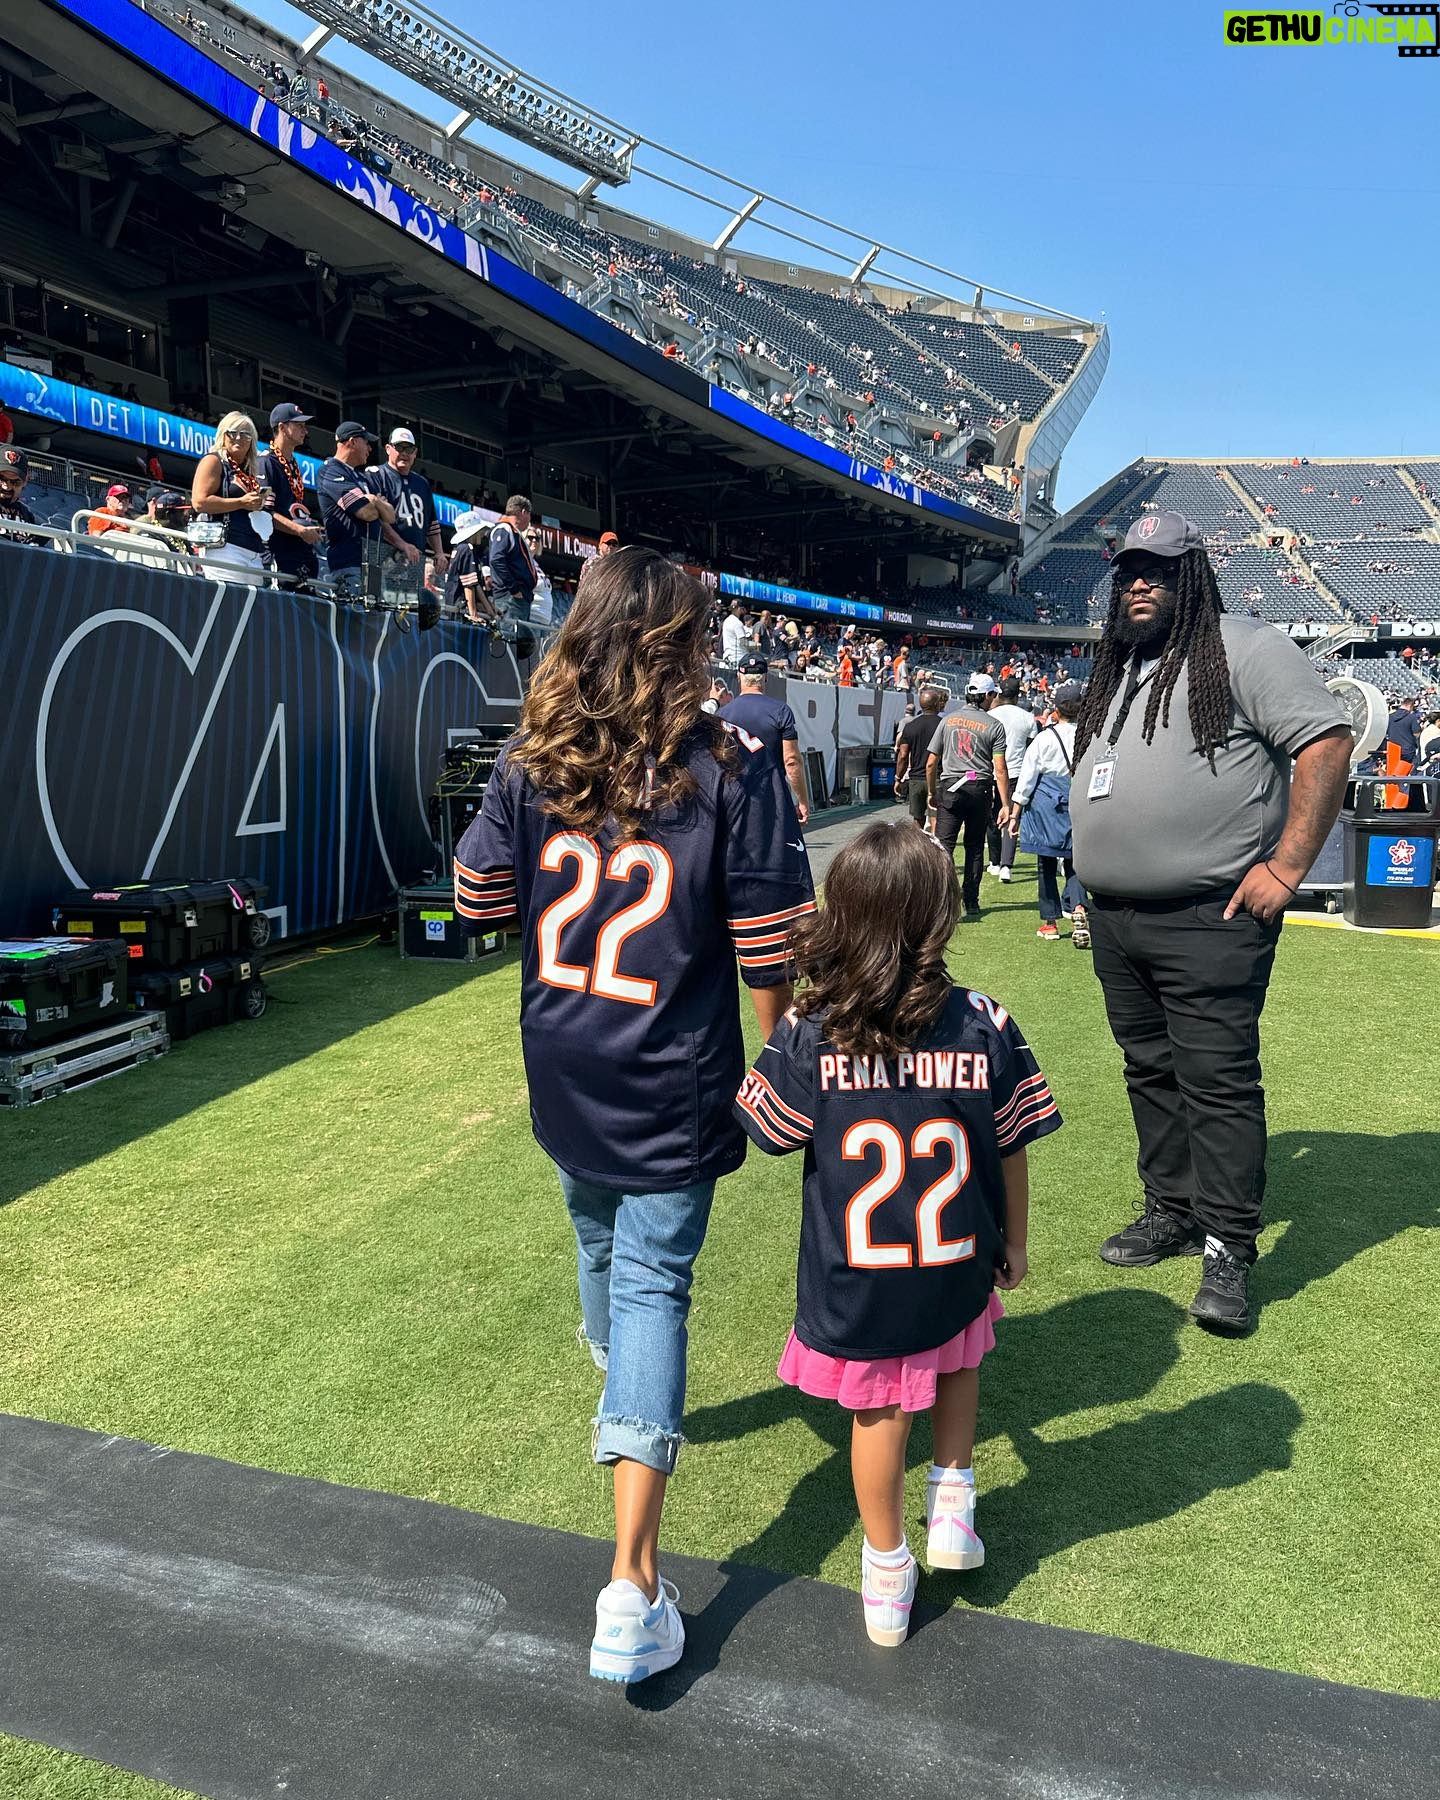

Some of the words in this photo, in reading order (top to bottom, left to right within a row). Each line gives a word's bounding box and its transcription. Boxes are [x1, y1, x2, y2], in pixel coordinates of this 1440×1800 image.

[90, 397, 131, 434] DET
[158, 417, 176, 447] D.
[302, 460, 316, 486] 21
[398, 491, 424, 529] 48
[563, 535, 573, 554] N.
[888, 610, 913, 624] HORIZON
[946, 716, 989, 733] SECURITY
[537, 830, 674, 1007] 22
[820, 1052, 891, 1091] PENA
[899, 1052, 990, 1090] POWER
[842, 1118, 976, 1268] 22
[939, 1494, 958, 1504] NIKE
[879, 1579, 897, 1589] NIKE
